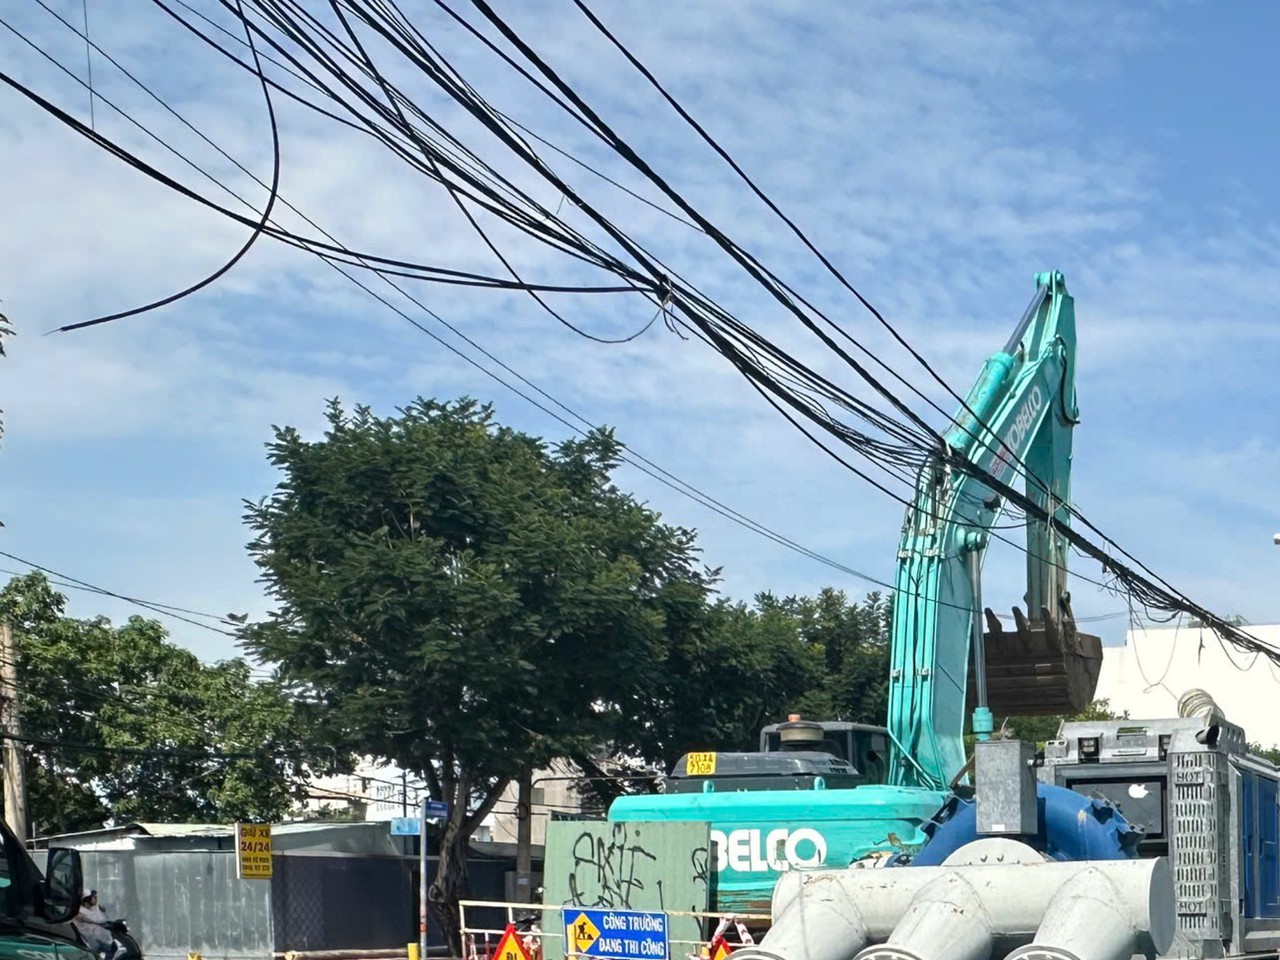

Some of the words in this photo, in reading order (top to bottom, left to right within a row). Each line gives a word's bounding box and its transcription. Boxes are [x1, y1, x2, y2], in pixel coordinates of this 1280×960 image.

[1176, 771, 1201, 783] HOT
[240, 841, 270, 853] 24/24
[603, 912, 627, 930] CÔNG
[623, 940, 639, 955] THI
[641, 938, 664, 956] CÔNG
